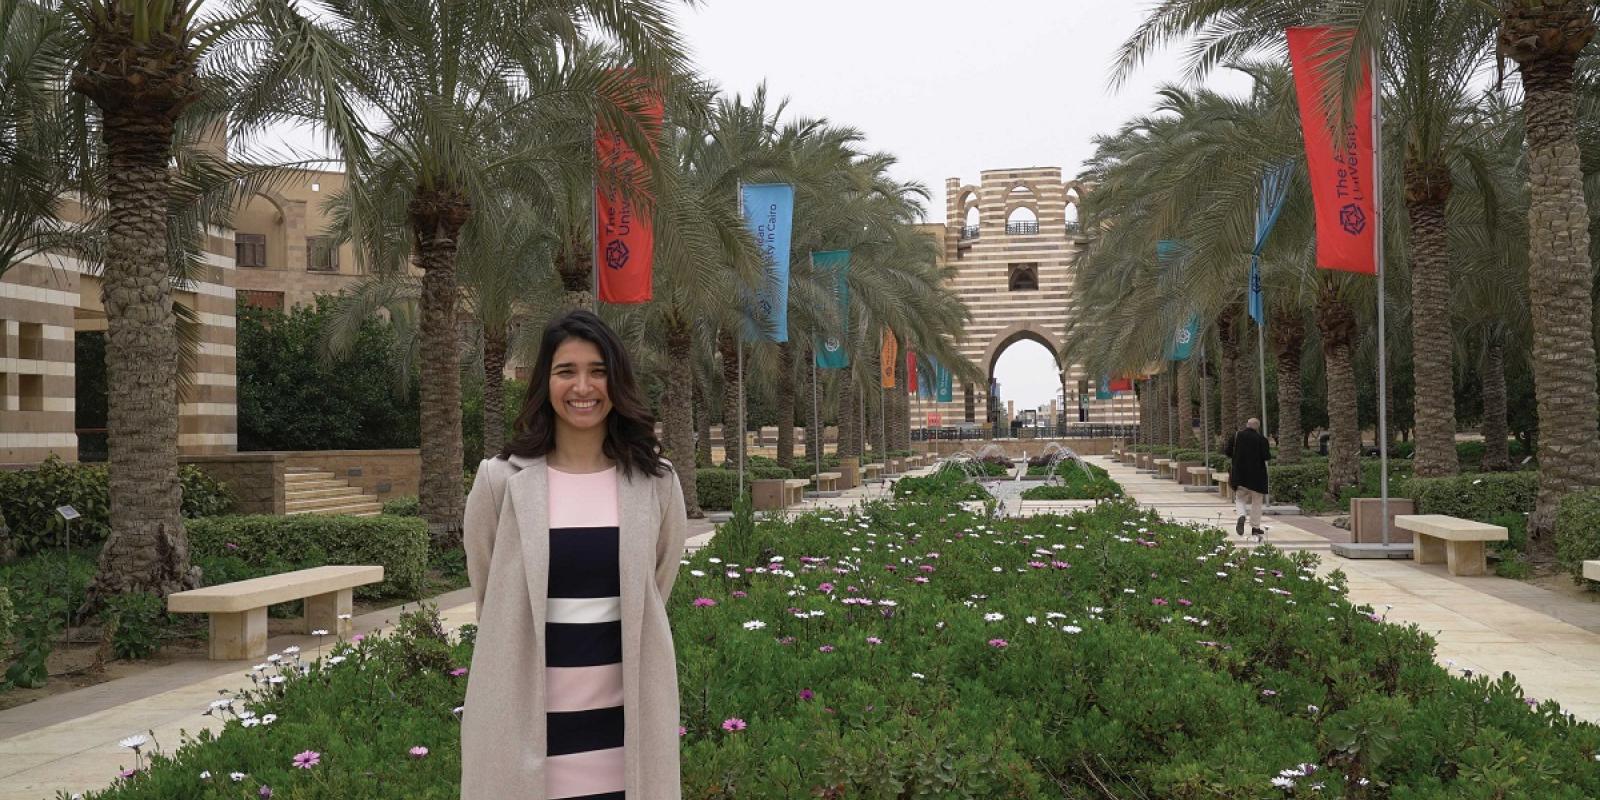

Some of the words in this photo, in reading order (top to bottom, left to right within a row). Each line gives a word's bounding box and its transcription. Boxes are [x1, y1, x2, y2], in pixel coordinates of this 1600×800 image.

[1336, 169, 1349, 198] The
[606, 207, 616, 236] The
[768, 203, 777, 231] Cairo
[767, 233, 775, 243] in
